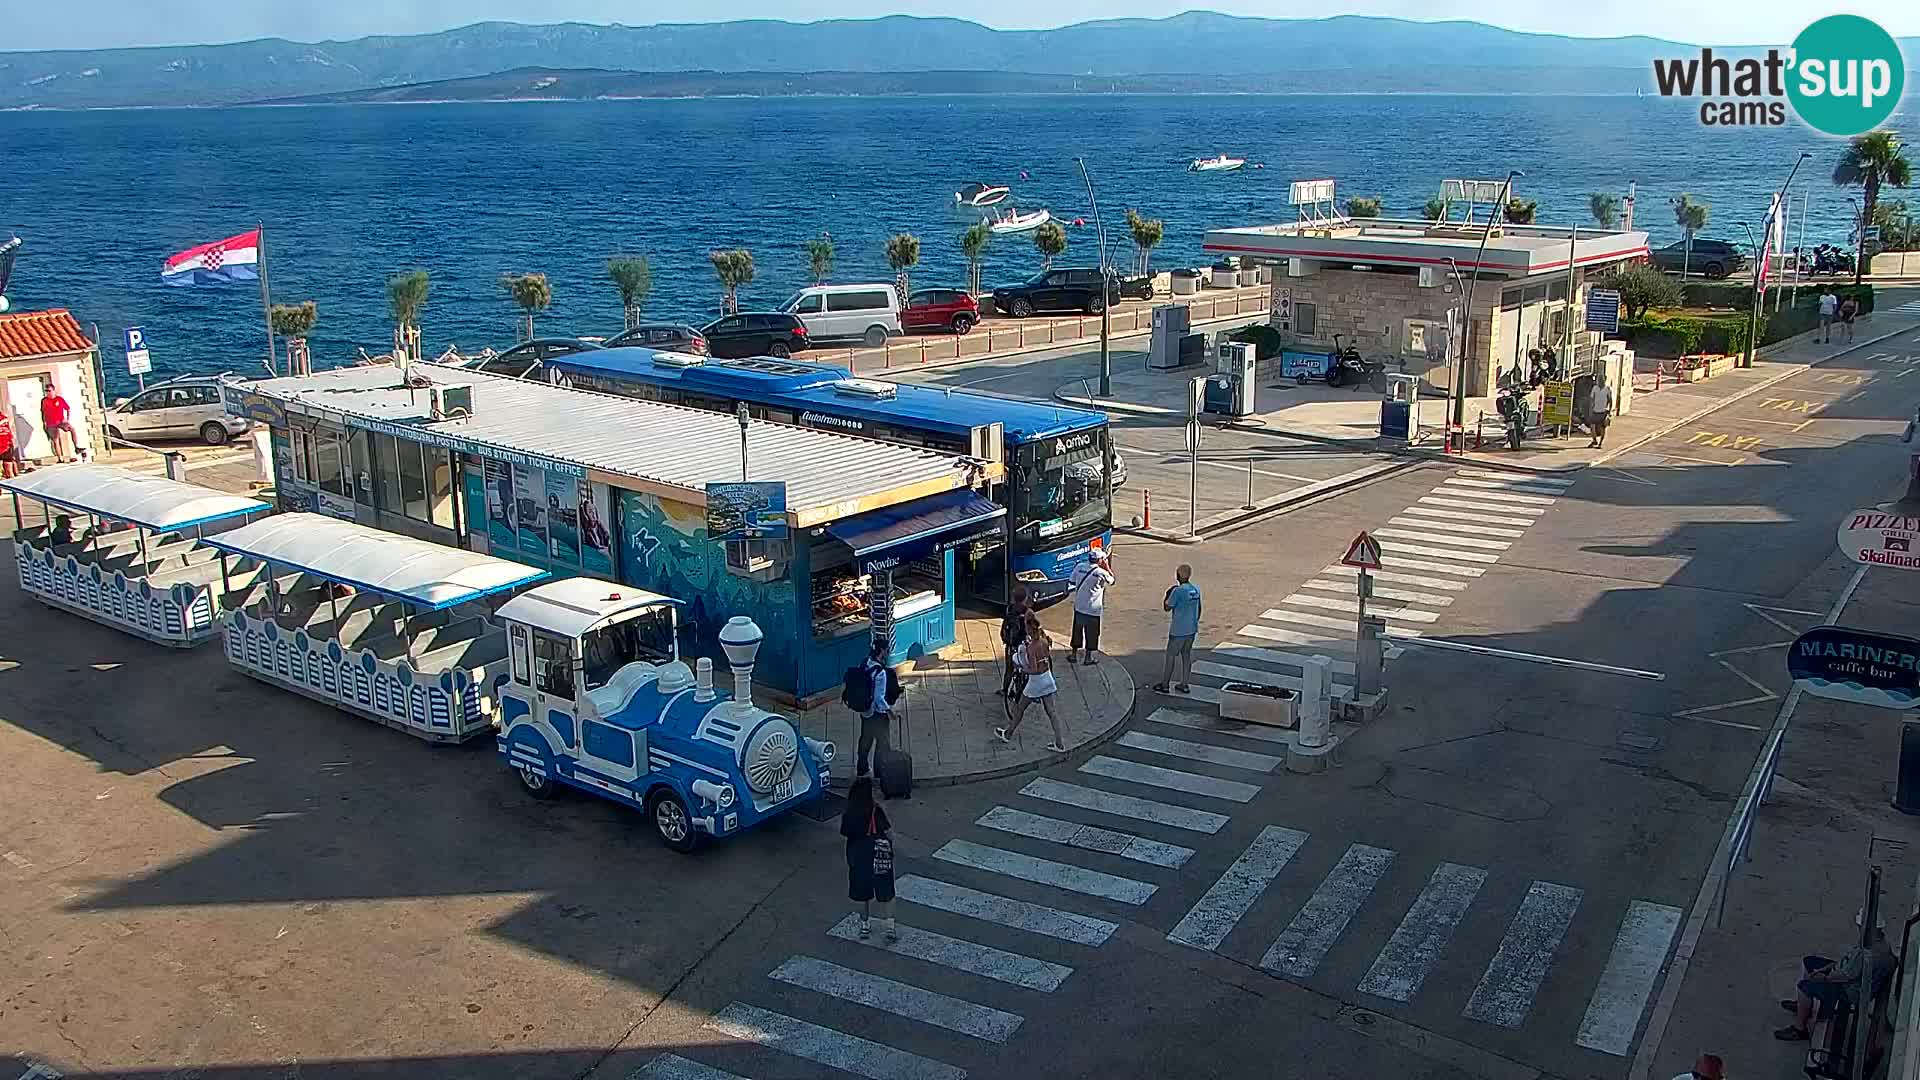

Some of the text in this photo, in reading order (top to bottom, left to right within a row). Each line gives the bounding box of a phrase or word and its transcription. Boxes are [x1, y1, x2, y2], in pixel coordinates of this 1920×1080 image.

[128, 330, 143, 349] P
[802, 410, 841, 426] Autotrans
[1685, 431, 1764, 450] TAXI
[435, 437, 469, 452] POSTAJA
[478, 445, 493, 458] BUS
[494, 448, 526, 465] STATION
[527, 456, 554, 471] TICKET
[555, 462, 582, 477] OFFICE
[1848, 514, 1920, 532] PIZZE
[1881, 529, 1917, 540] GRILL
[1828, 662, 1896, 679] caffe bar
